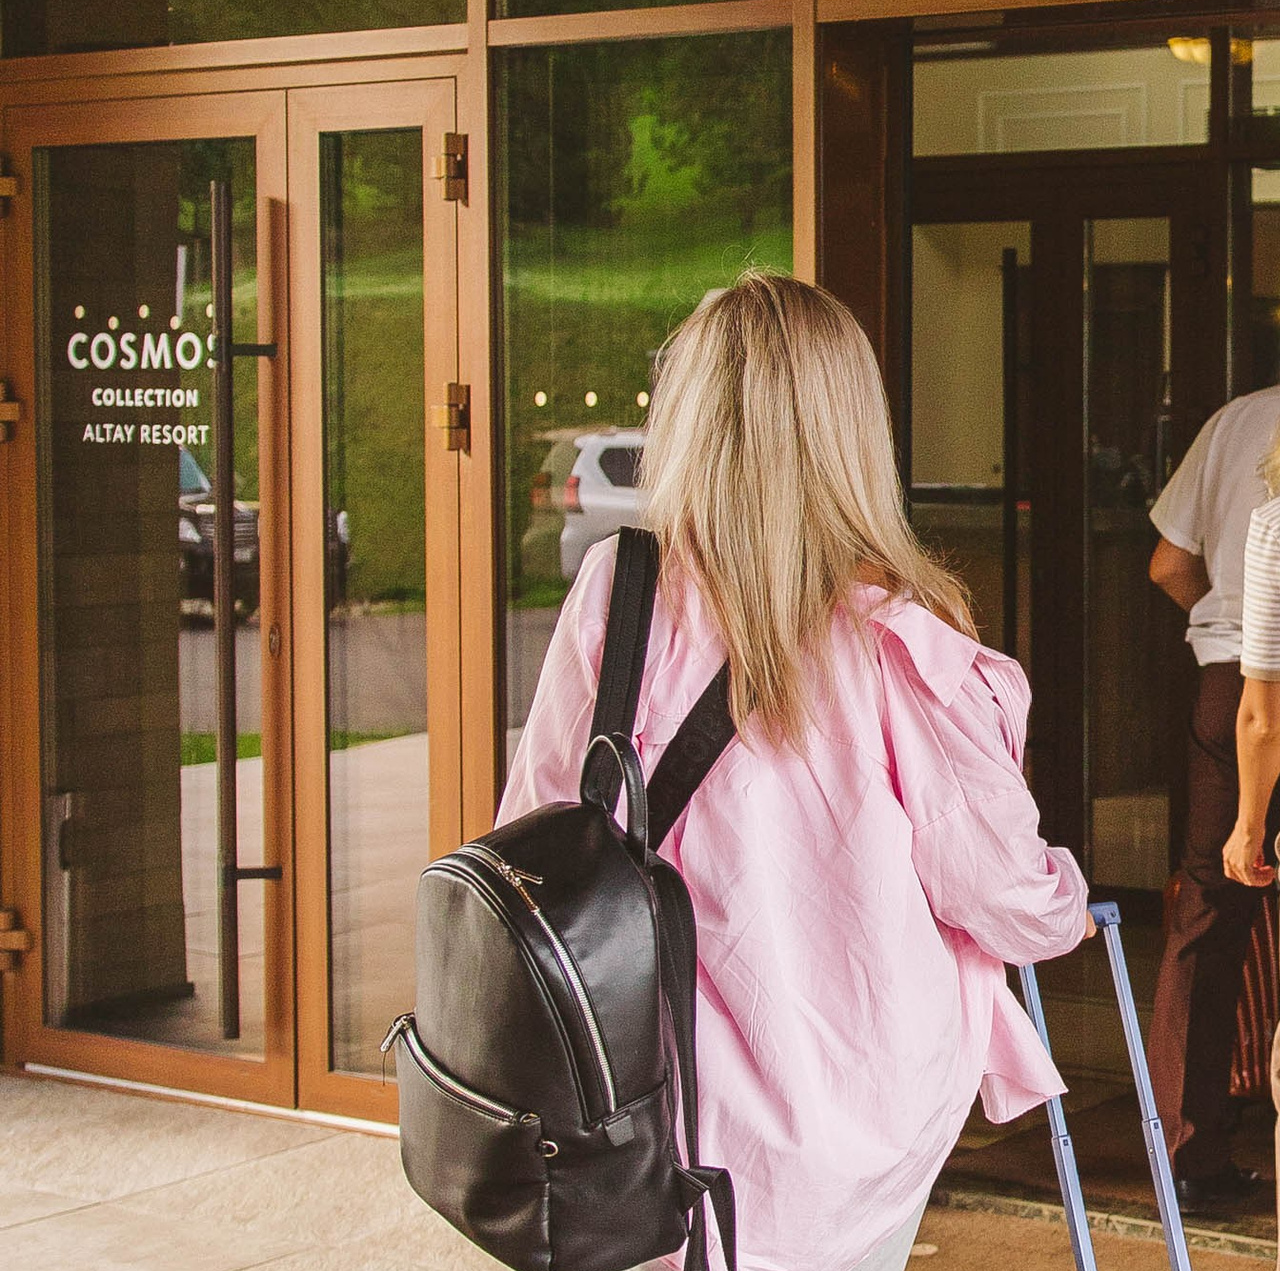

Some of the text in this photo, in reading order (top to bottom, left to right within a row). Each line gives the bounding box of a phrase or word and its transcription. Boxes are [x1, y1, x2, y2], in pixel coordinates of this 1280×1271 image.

[92, 388, 199, 408] COLLECTION
[82, 423, 209, 445] ALTAY RESORT
